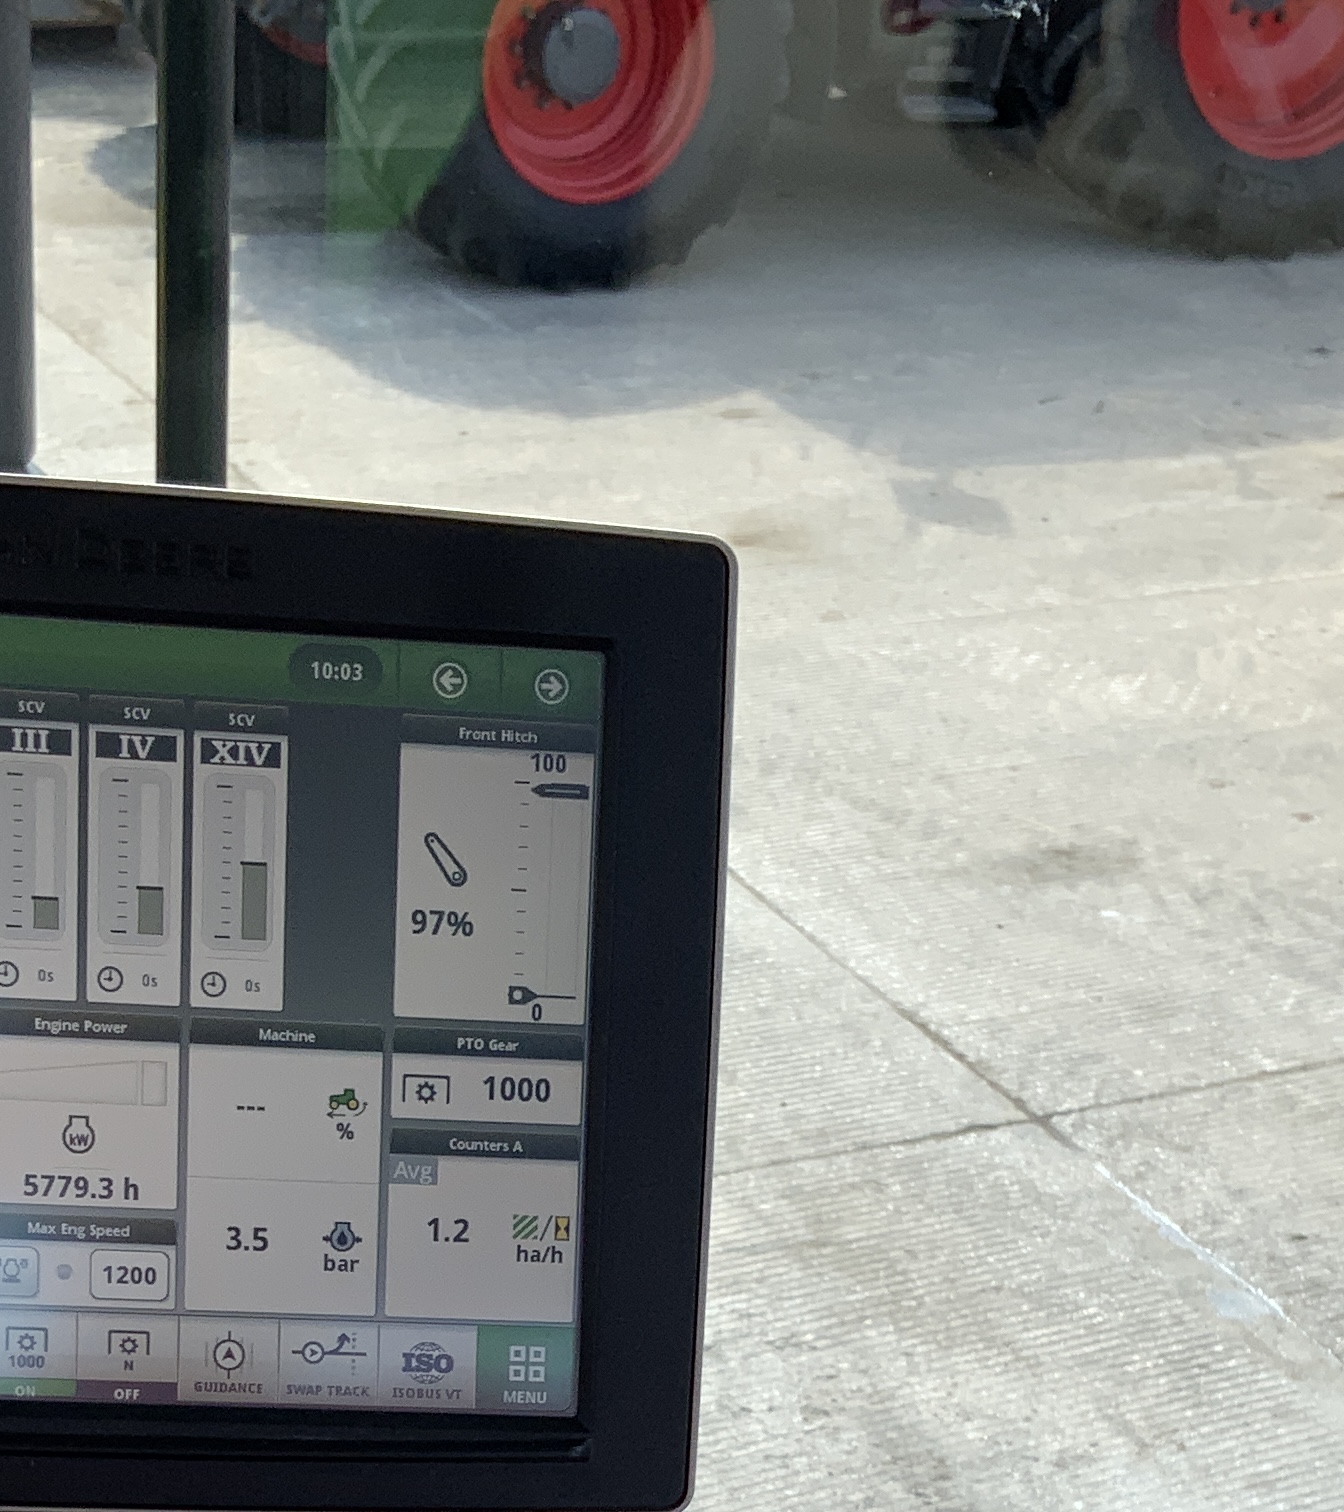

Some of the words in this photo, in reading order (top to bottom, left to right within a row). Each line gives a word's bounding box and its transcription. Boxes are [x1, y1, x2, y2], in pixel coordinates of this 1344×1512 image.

[310, 659, 364, 683] 10:03
[17, 699, 47, 715] SCV
[123, 705, 152, 722] SCV
[228, 712, 256, 728] SCV
[11, 727, 51, 754] III
[458, 725, 497, 743] Front
[501, 726, 539, 744] Hitch
[118, 734, 156, 760] IV
[210, 740, 272, 767] XIV
[530, 752, 568, 774] 100
[410, 909, 474, 938] 97%
[37, 968, 55, 984] 0s
[141, 973, 158, 989] 0s
[244, 979, 261, 994] 0s
[531, 1003, 543, 1022] 0
[34, 1016, 81, 1036] Engine
[83, 1019, 128, 1036] Power
[258, 1027, 317, 1046] Machine
[456, 1036, 484, 1052] PTO
[487, 1037, 520, 1054] Gear
[482, 1075, 552, 1103] 1000
[68, 1131, 90, 1148] kW
[336, 1121, 355, 1142] %
[449, 1136, 510, 1154] Counters
[512, 1139, 524, 1154] A
[393, 1160, 434, 1186] Avg
[22, 1173, 114, 1200] 5779.3
[123, 1176, 140, 1201] h
[27, 1221, 54, 1238] Max
[59, 1222, 88, 1241] Eng
[90, 1222, 131, 1242] Speed
[224, 1225, 270, 1252] 3.5
[427, 1217, 471, 1245] 1.2
[322, 1253, 360, 1274] bar
[515, 1244, 564, 1265] ha/h
[102, 1265, 157, 1286] 1200
[9, 1354, 46, 1371] 1000
[123, 1358, 135, 1372] N
[402, 1352, 455, 1376] ISO
[14, 1383, 37, 1398] ON
[113, 1386, 141, 1401] OFF
[193, 1380, 264, 1396] GUIDANCE
[286, 1382, 324, 1397] SWAP
[327, 1384, 370, 1399] TRACK
[391, 1386, 440, 1401] ISOBUS
[443, 1387, 463, 1402] VT
[503, 1389, 548, 1405] MENU
